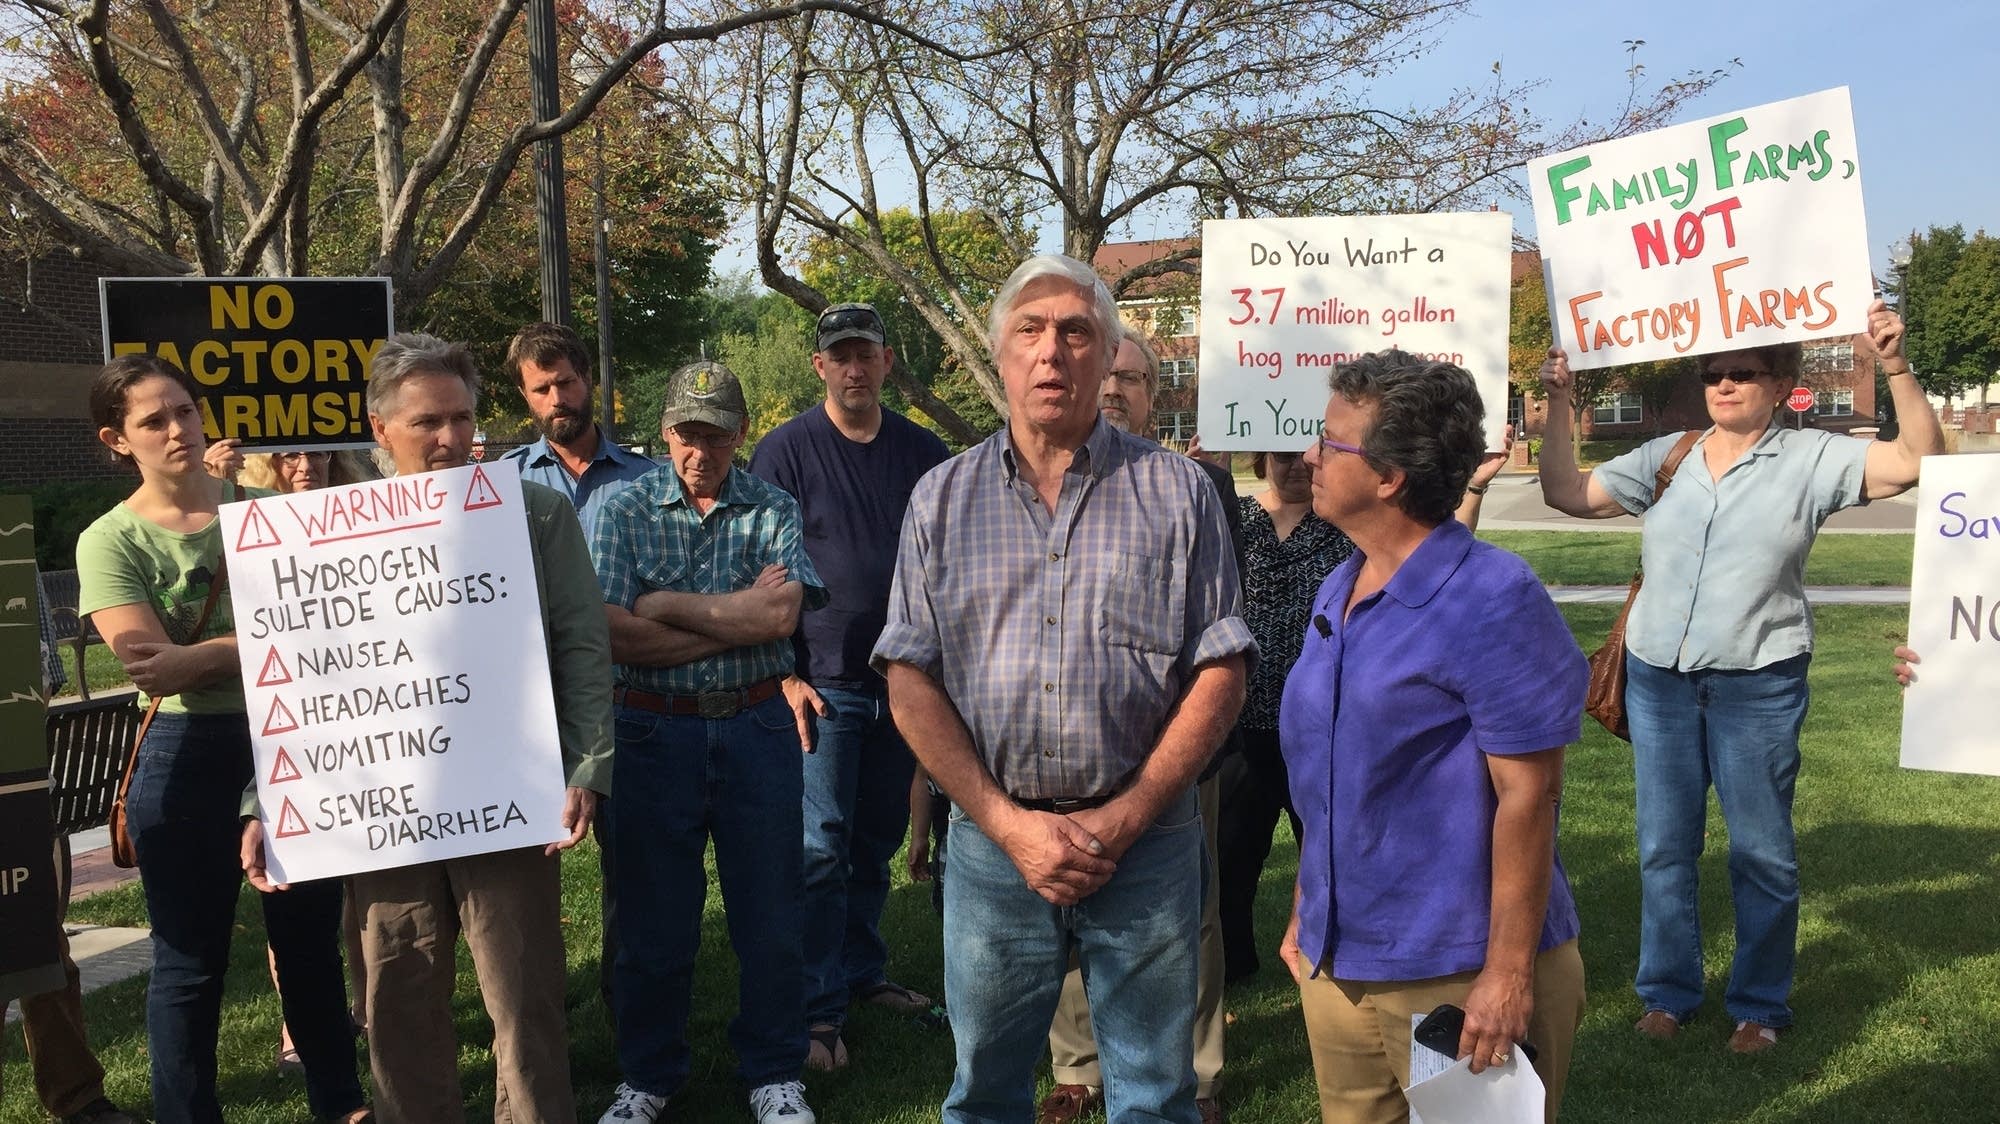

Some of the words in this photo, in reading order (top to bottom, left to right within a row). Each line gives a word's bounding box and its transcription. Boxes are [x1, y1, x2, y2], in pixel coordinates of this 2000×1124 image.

[1547, 155, 1698, 225] FAMILY
[1708, 116, 1855, 190] FARMS,
[1251, 242, 1281, 266] Do
[1287, 240, 1329, 267] You
[1344, 237, 1417, 267] Want
[1427, 247, 1444, 263] a
[210, 285, 294, 330] NO
[1229, 287, 1286, 326] 3.7
[1296, 298, 1369, 325] million
[1382, 296, 1455, 336] gallon
[1569, 291, 1699, 353] FACTORY
[1712, 257, 1837, 339] FARMS
[1239, 341, 1281, 379] hog
[1296, 351, 1360, 367] man
[201, 392, 362, 438] ARMS!
[1225, 401, 1251, 437] In
[1265, 398, 1325, 436] Your
[1790, 394, 1812, 404] STOP
[285, 478, 448, 538] WARNING
[272, 544, 440, 600] HYDROGEN
[251, 591, 375, 639] SULFIDE
[395, 572, 507, 616] CAUSES:
[297, 638, 414, 679] NAUSEA
[300, 673, 471, 727] HEADACHES
[304, 726, 451, 774] VOMITING
[315, 784, 419, 832] SEVERE
[367, 801, 528, 851] DIARRHEA
